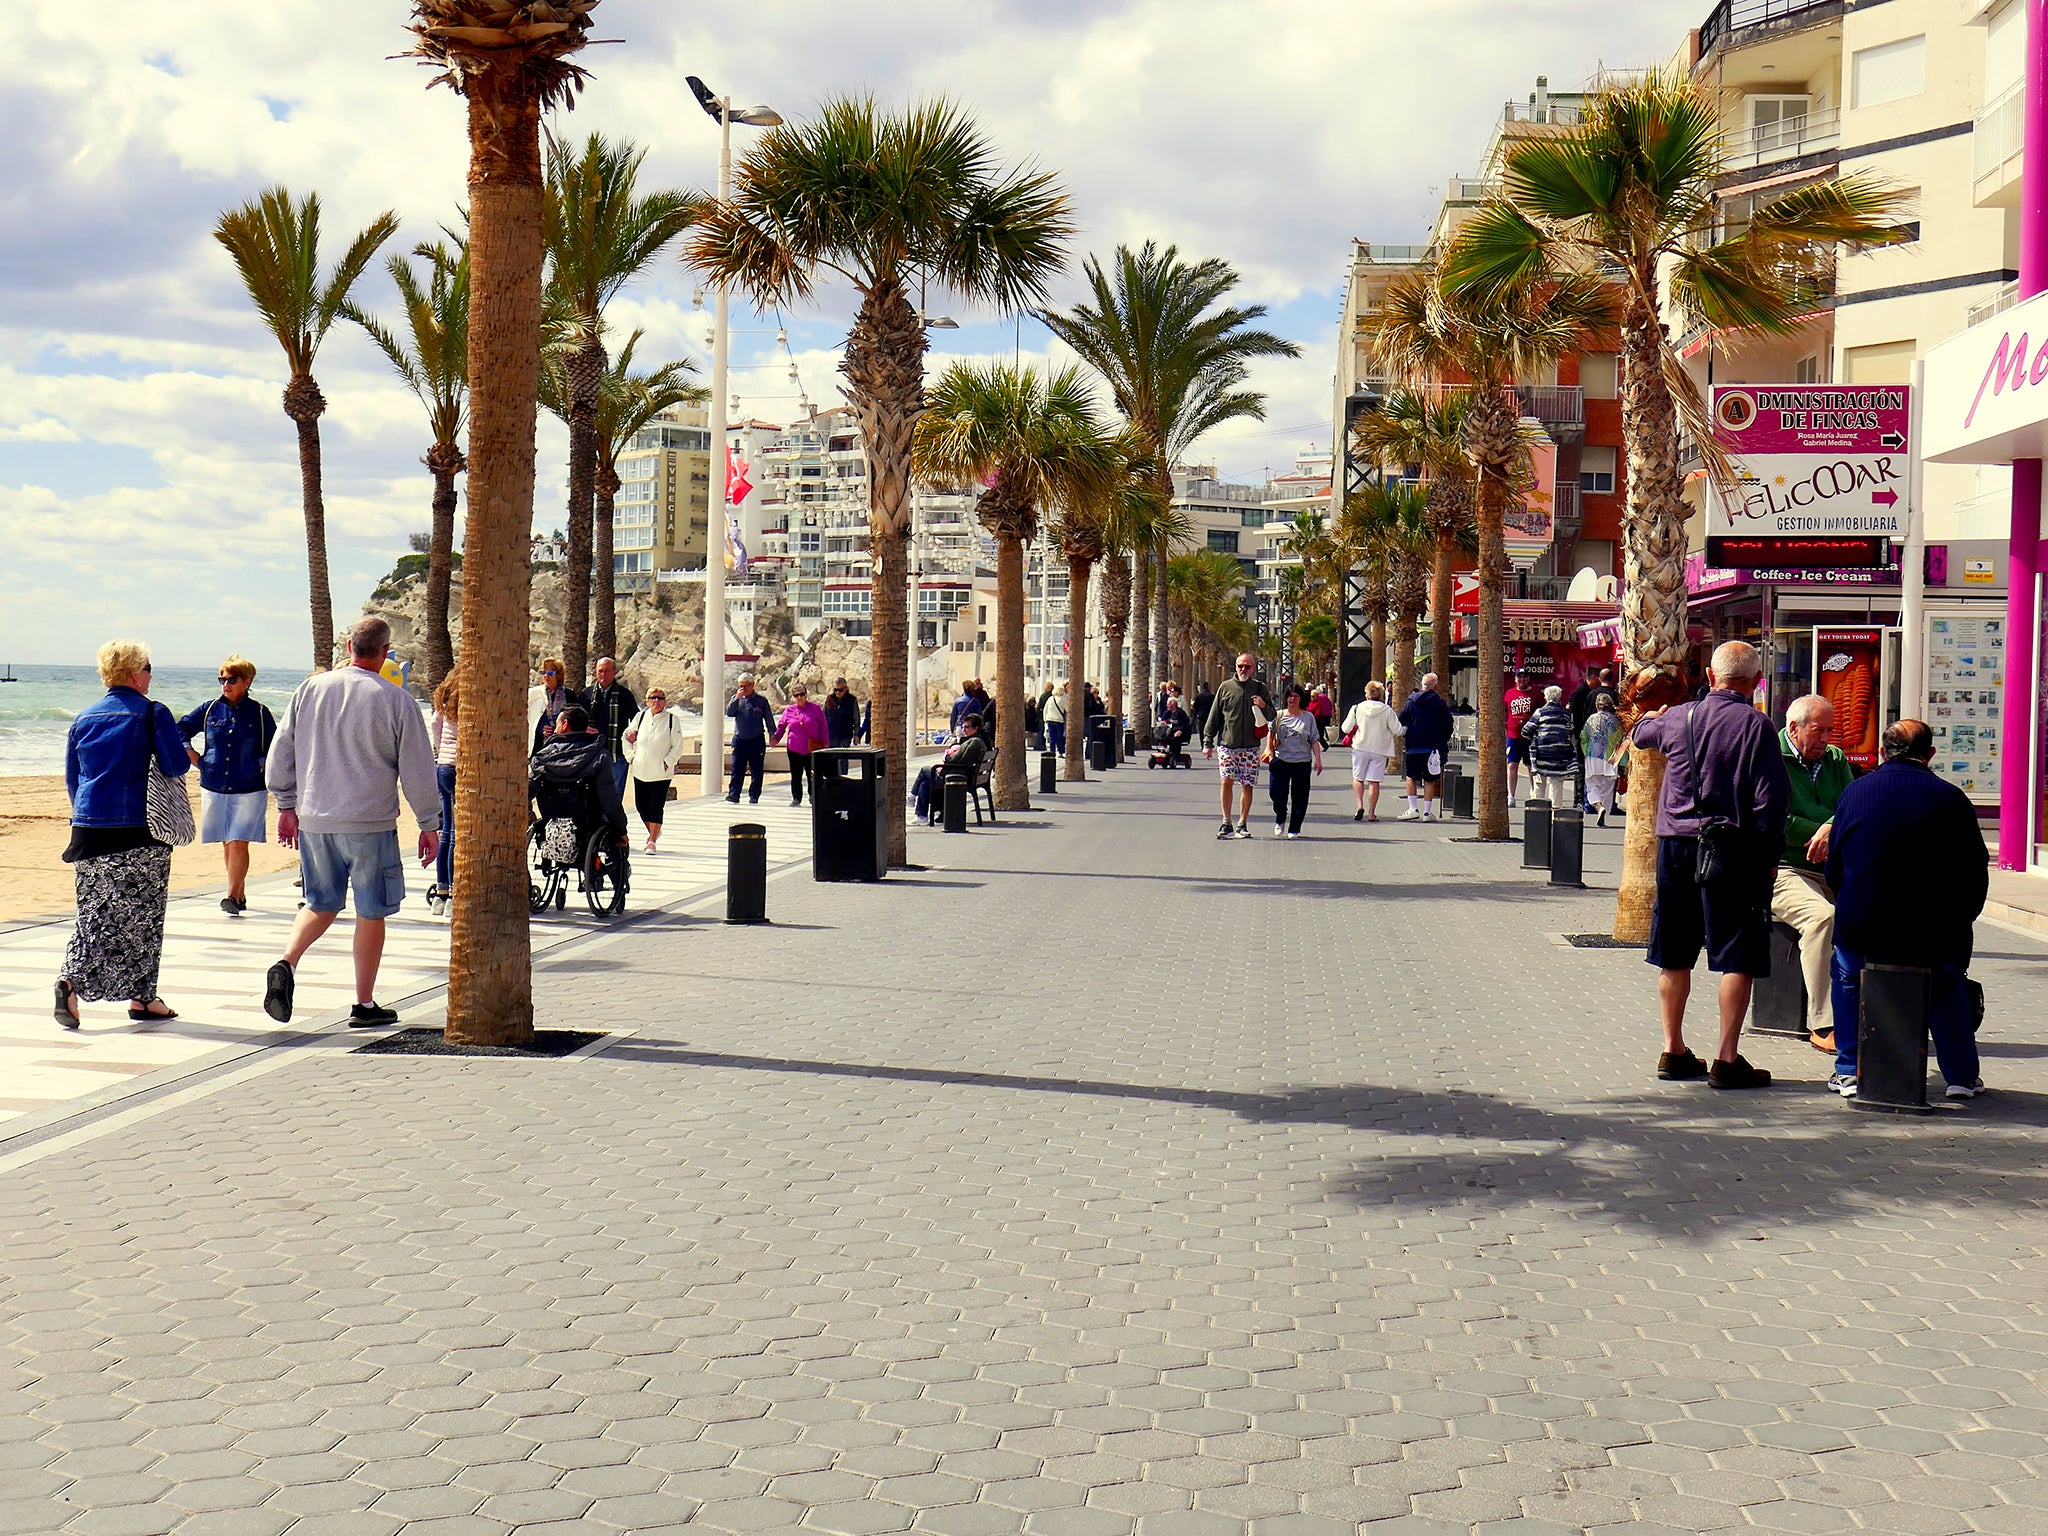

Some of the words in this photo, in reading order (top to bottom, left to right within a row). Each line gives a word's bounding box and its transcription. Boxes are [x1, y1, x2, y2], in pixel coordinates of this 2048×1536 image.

[1780, 411, 1807, 430] DE
[1812, 411, 1879, 430] FINCAS
[1798, 432, 1815, 440] Rosa
[1803, 439, 1827, 447] Gabriel
[1828, 439, 1852, 447] Medina
[667, 467, 676, 530] VENECIA
[1777, 517, 1821, 531] GESTION
[1824, 516, 1898, 531] INMOBILIARIA
[1752, 569, 1792, 581] Coffee
[1801, 570, 1823, 581] Ice
[1825, 571, 1872, 582] Cream
[1509, 617, 1579, 641] SALON
